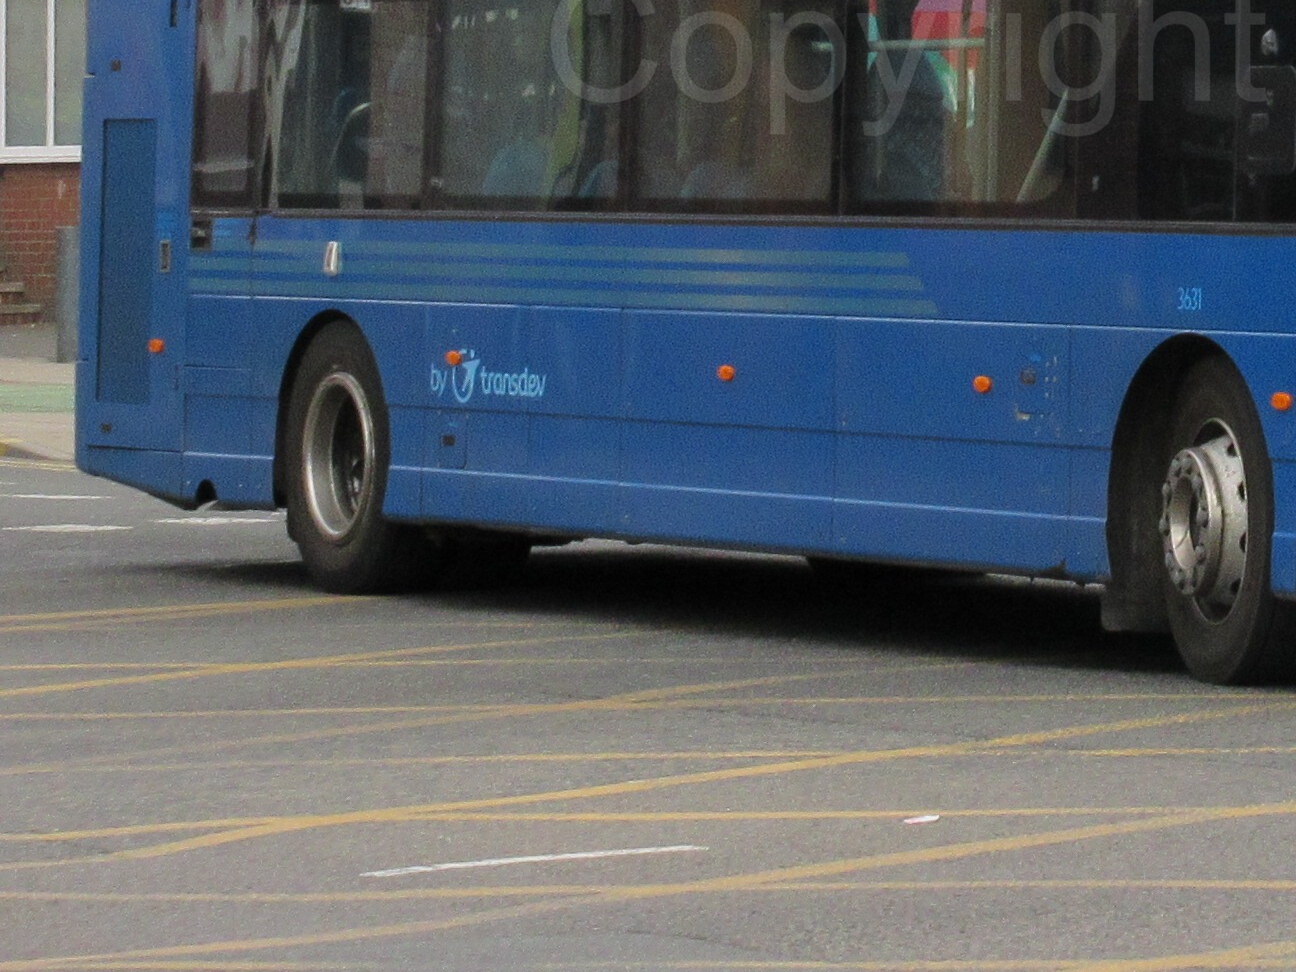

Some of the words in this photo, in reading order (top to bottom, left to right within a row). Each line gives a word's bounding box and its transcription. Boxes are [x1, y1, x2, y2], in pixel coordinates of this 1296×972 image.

[1177, 286, 1202, 310] 3631
[430, 362, 448, 397] by
[480, 366, 548, 397] transdev
